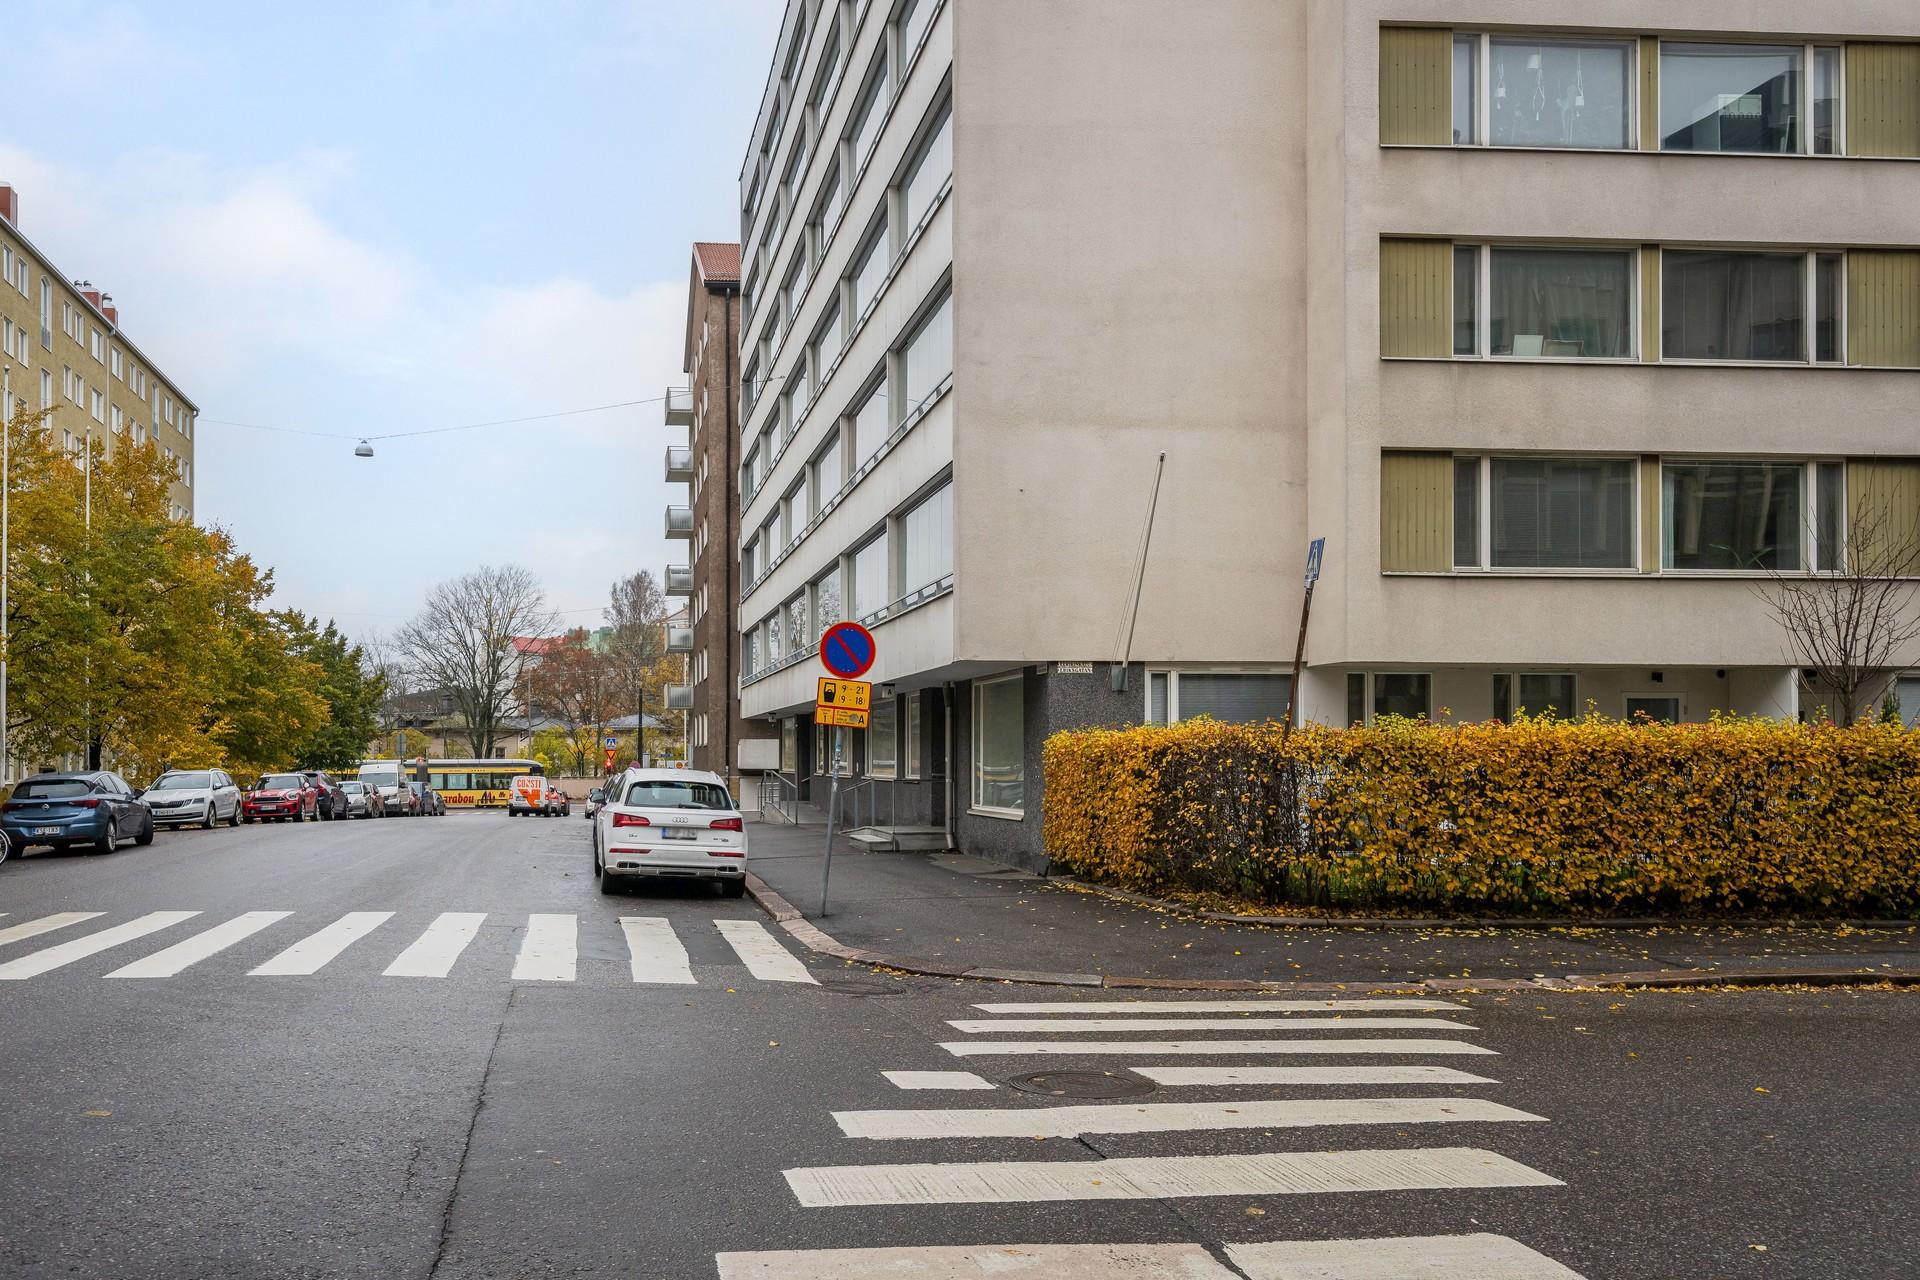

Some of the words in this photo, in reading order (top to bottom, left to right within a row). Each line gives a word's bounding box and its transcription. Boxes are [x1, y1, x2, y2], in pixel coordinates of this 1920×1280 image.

[841, 685, 847, 693] 9
[856, 686, 864, 695] 21
[858, 714, 865, 725] A
[517, 779, 541, 789] CONSTI
[443, 793, 474, 804] arabou
